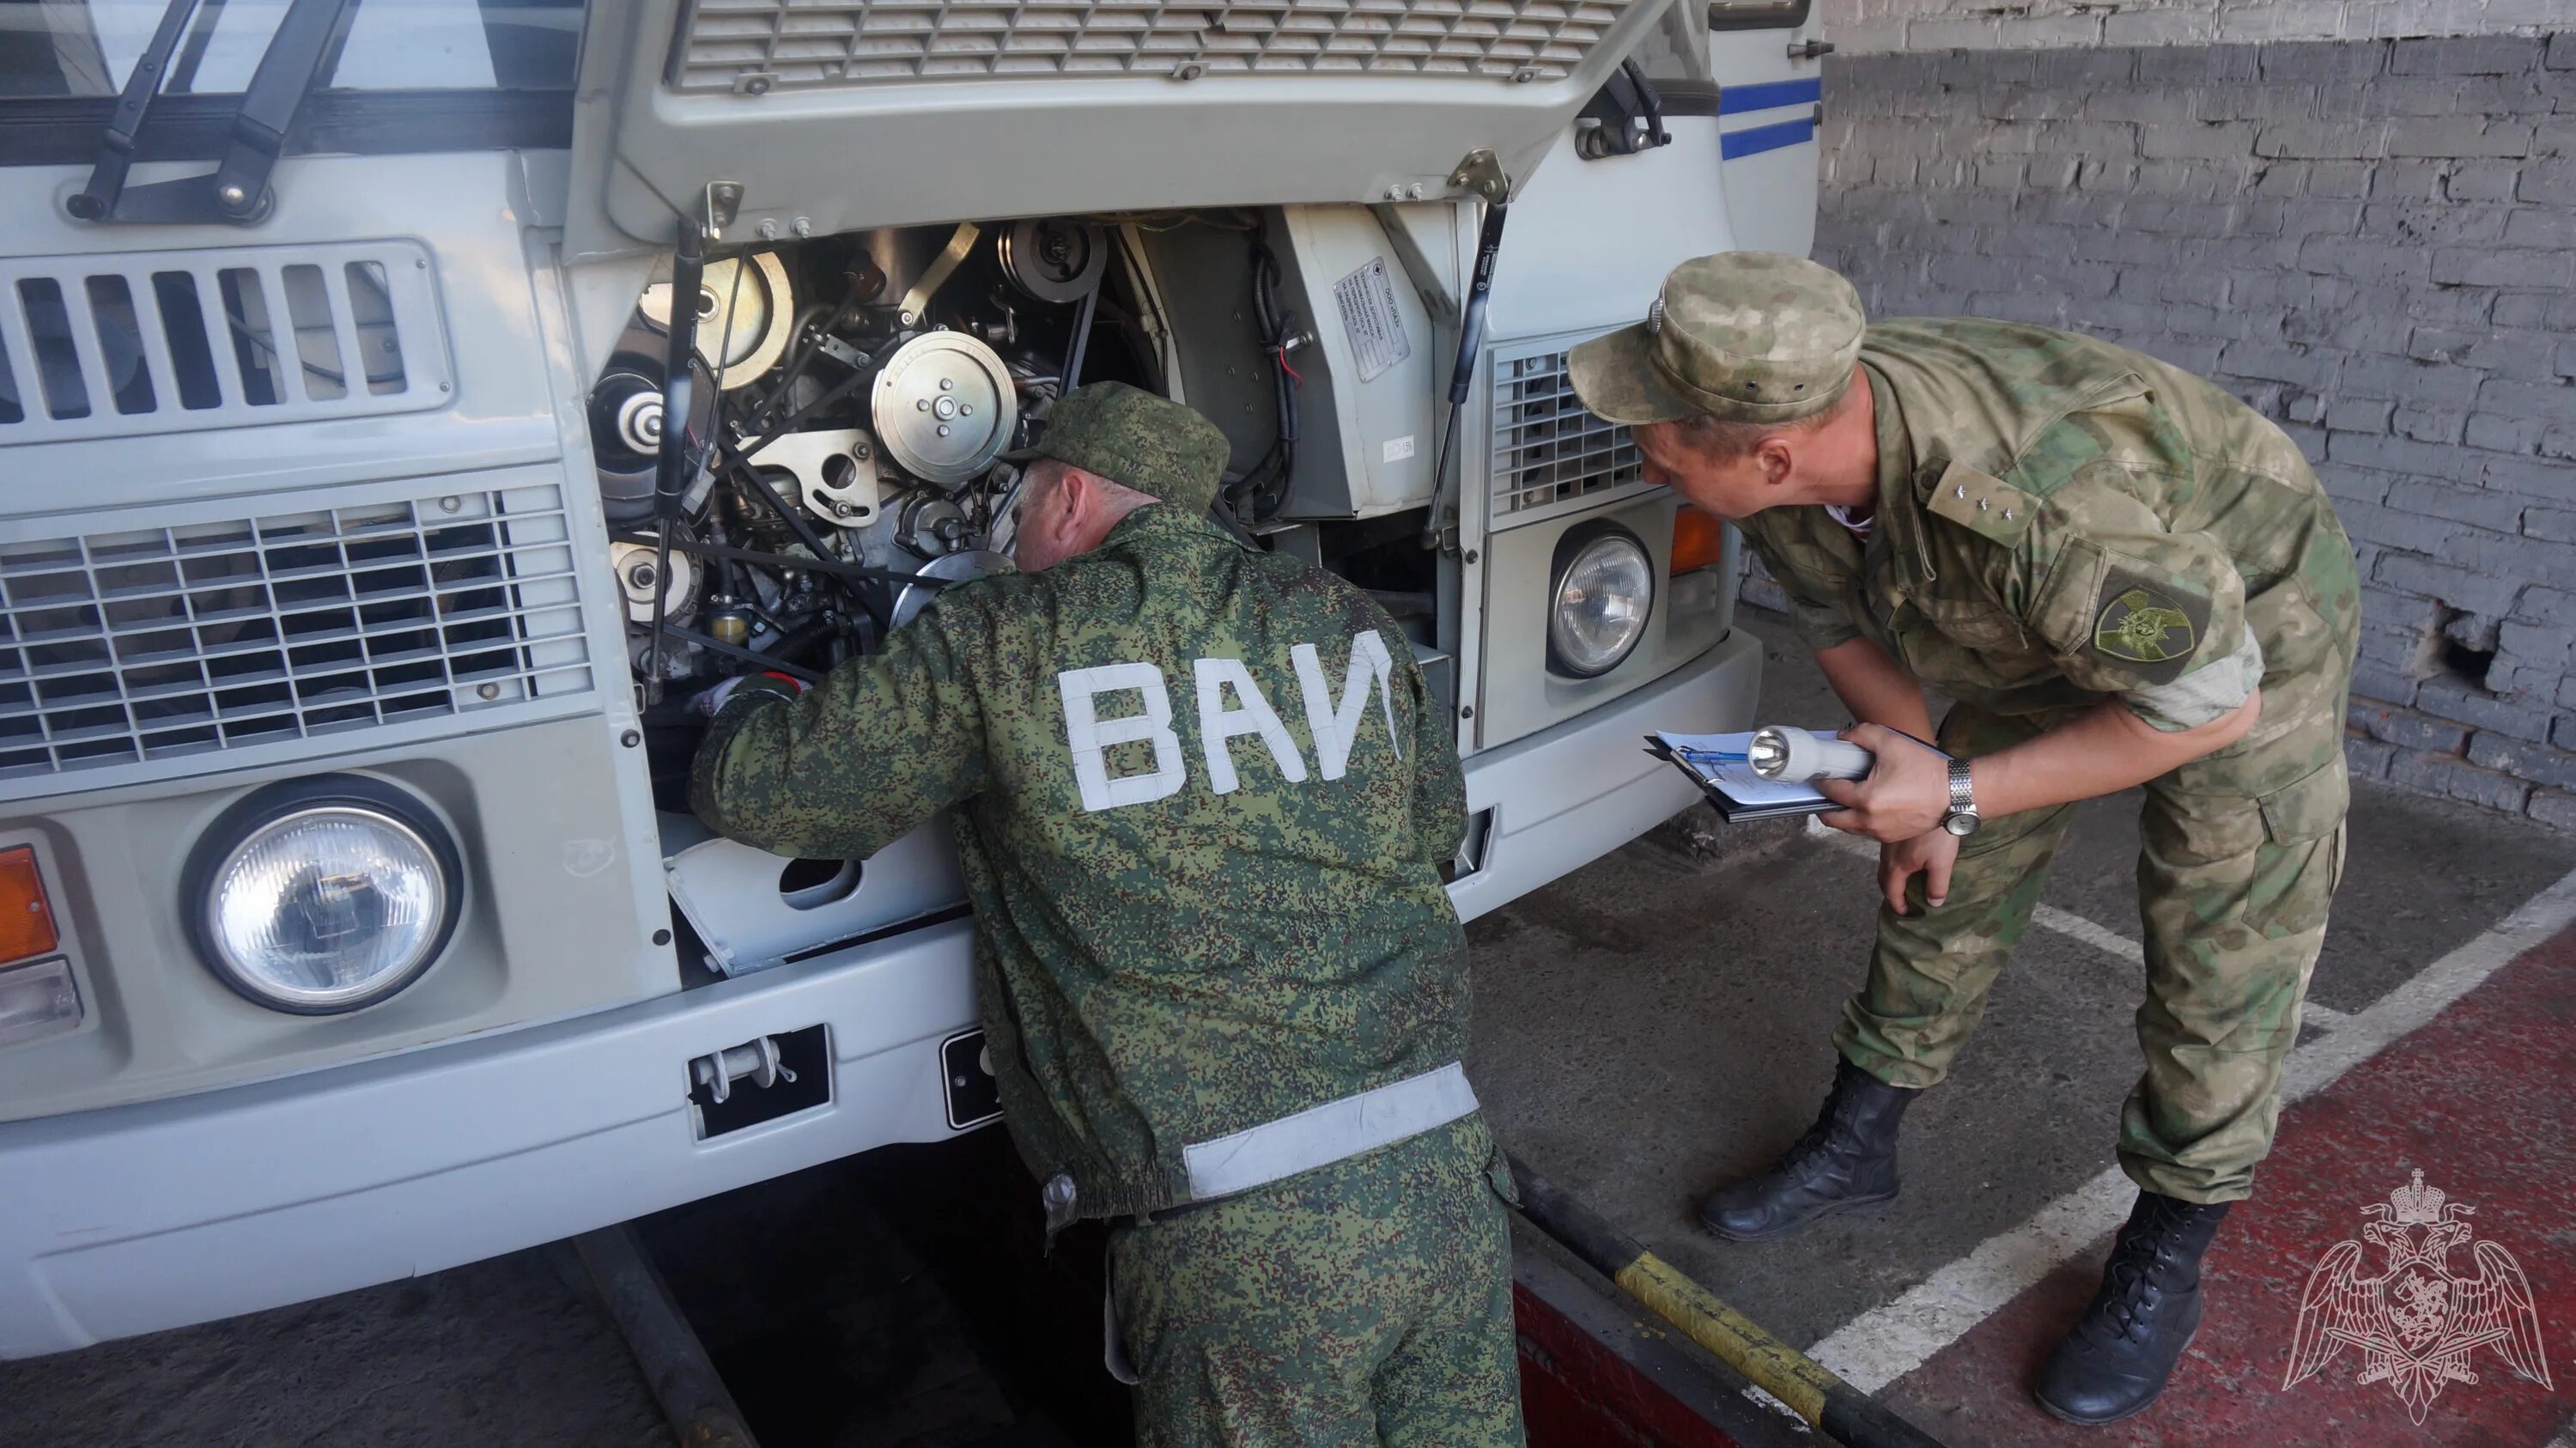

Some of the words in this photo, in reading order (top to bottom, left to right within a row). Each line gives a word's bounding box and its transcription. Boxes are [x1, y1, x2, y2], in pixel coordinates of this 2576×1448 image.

[1344, 290, 1355, 315] ЗАДНЮЮ
[1350, 286, 1363, 318] ПЕРЕДНЮЮ
[1353, 274, 1370, 319] МАКСИМАЛЬНАЯ
[1360, 271, 1373, 306] ТЕХНИЧЕСКИ
[1369, 305, 1383, 341] ДОПУСТИМАЯ
[1384, 287, 1394, 306] ООО
[1058, 629, 1403, 812] ВАИ
